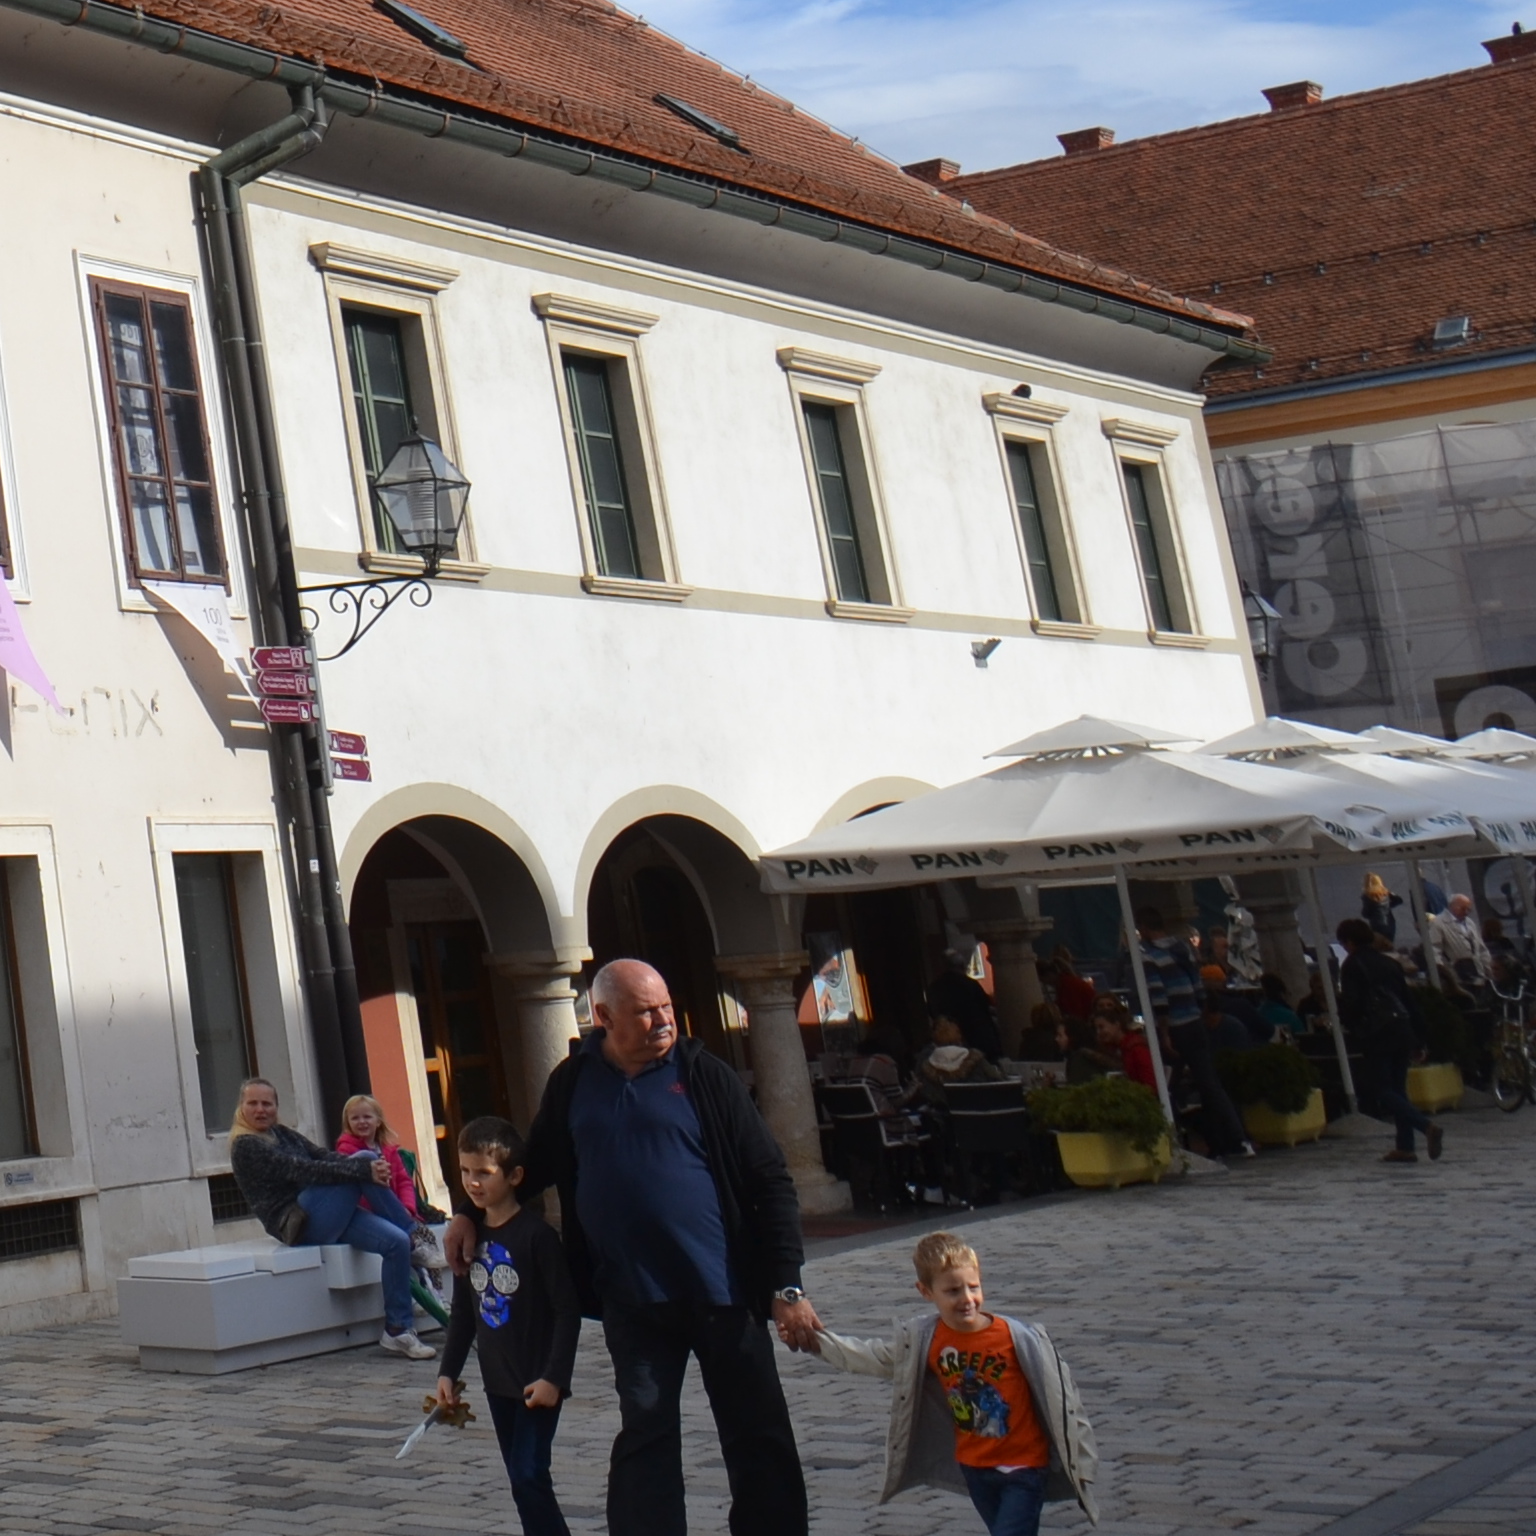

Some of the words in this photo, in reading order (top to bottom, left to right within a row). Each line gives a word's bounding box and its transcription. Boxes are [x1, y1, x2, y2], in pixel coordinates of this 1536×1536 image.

[1179, 828, 1256, 848] PAN
[911, 850, 983, 870] PAN
[1042, 840, 1117, 860] PAN
[784, 857, 853, 880] PAN
[936, 1350, 1008, 1381] CREEPS
